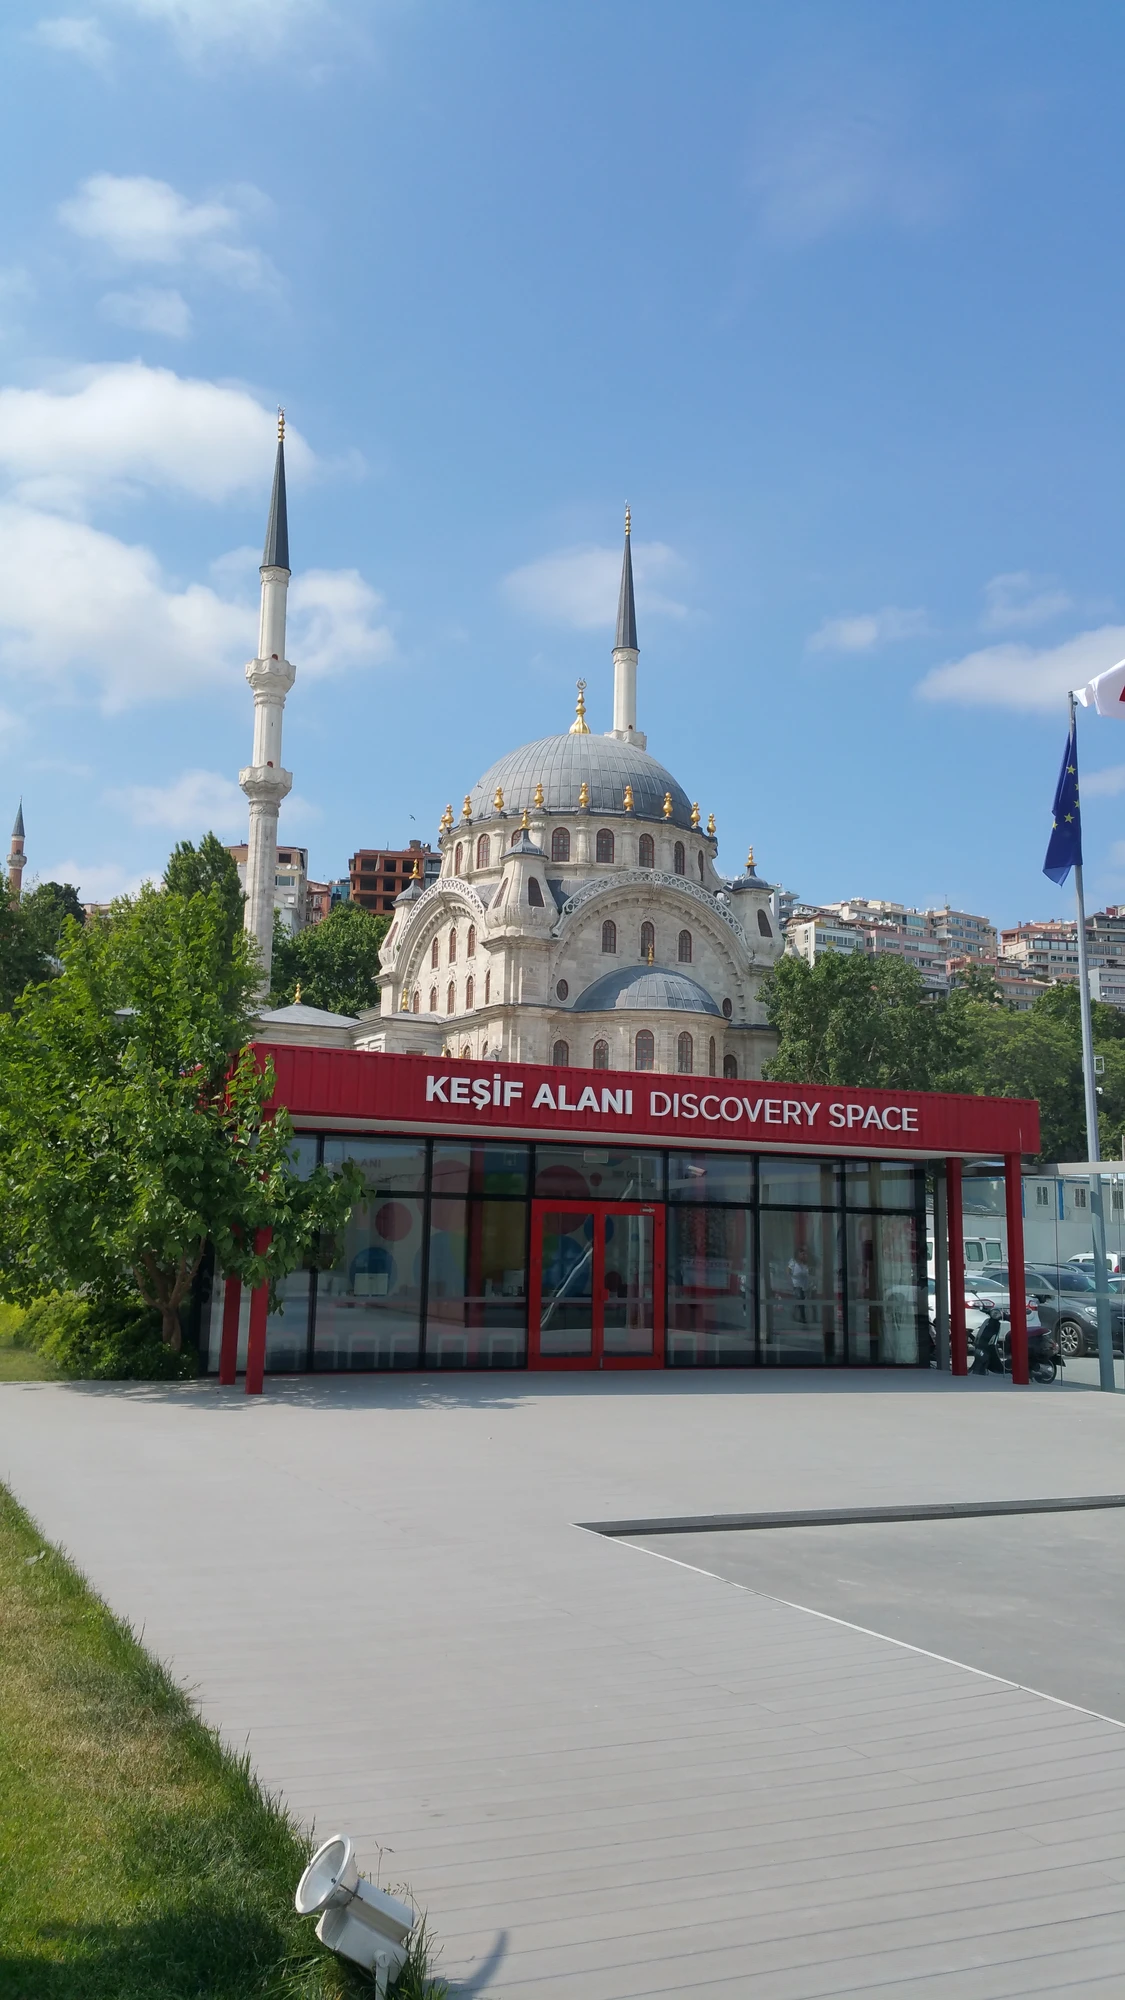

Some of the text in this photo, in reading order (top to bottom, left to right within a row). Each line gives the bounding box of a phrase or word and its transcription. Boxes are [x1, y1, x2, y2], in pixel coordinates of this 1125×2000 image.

[425, 1073, 919, 1132] KEŞİF ALANI DISCOVERY SPACE
